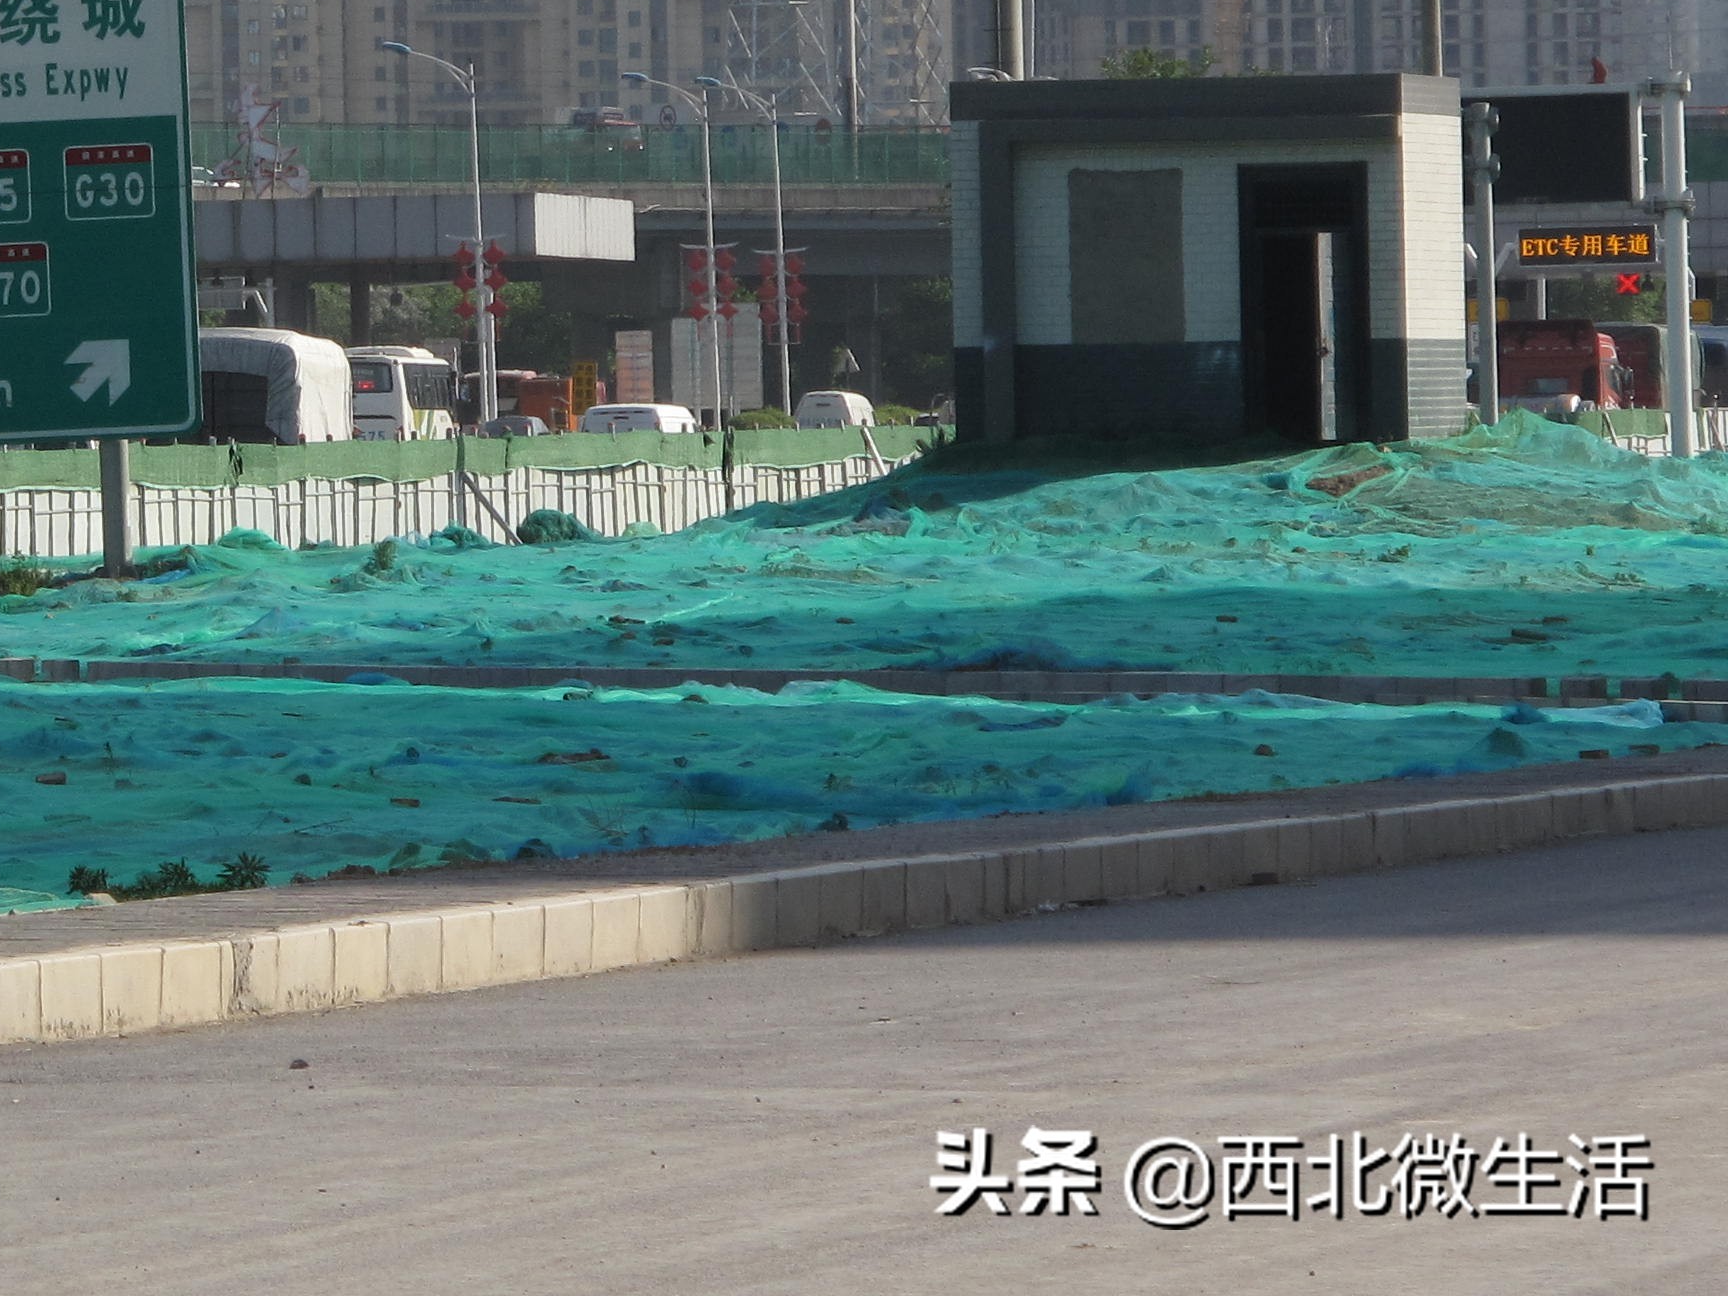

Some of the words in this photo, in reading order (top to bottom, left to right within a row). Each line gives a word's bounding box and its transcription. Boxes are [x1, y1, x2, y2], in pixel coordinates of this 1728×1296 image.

[45, 62, 129, 99] Expwy
[75, 172, 145, 208] G30
[1522, 233, 1650, 257] ETC专用车道
